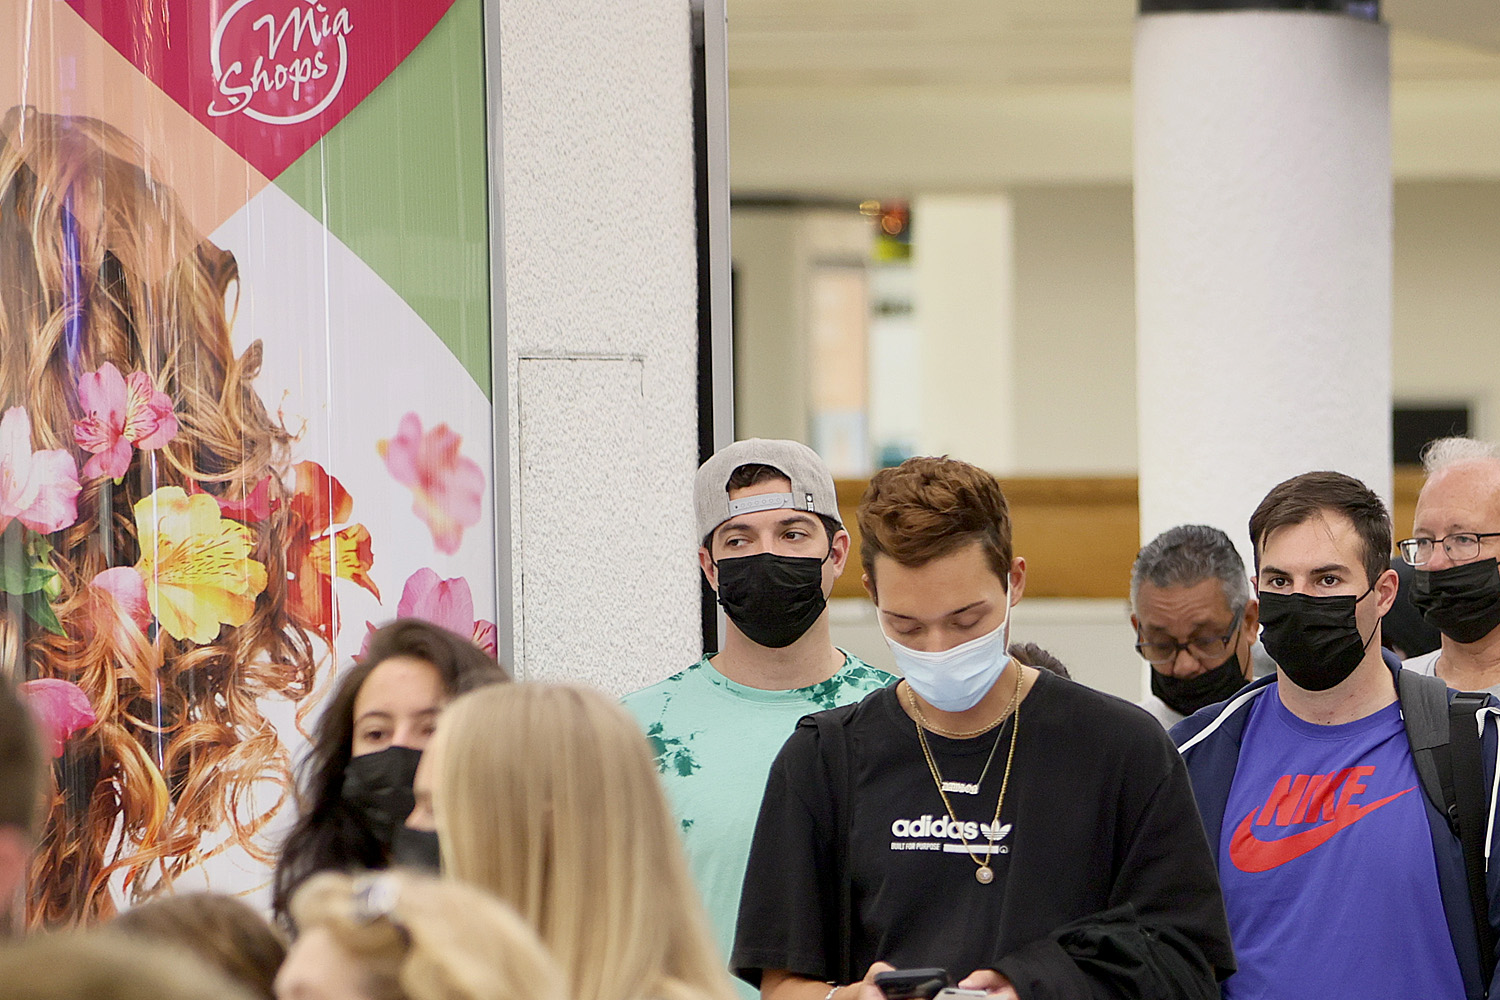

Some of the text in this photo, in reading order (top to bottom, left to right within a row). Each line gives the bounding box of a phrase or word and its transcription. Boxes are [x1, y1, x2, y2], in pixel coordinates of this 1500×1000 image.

[253, 3, 353, 59] Mia
[207, 51, 328, 116] Shops
[1255, 766, 1376, 827] NIKE
[891, 814, 979, 840] adidas
